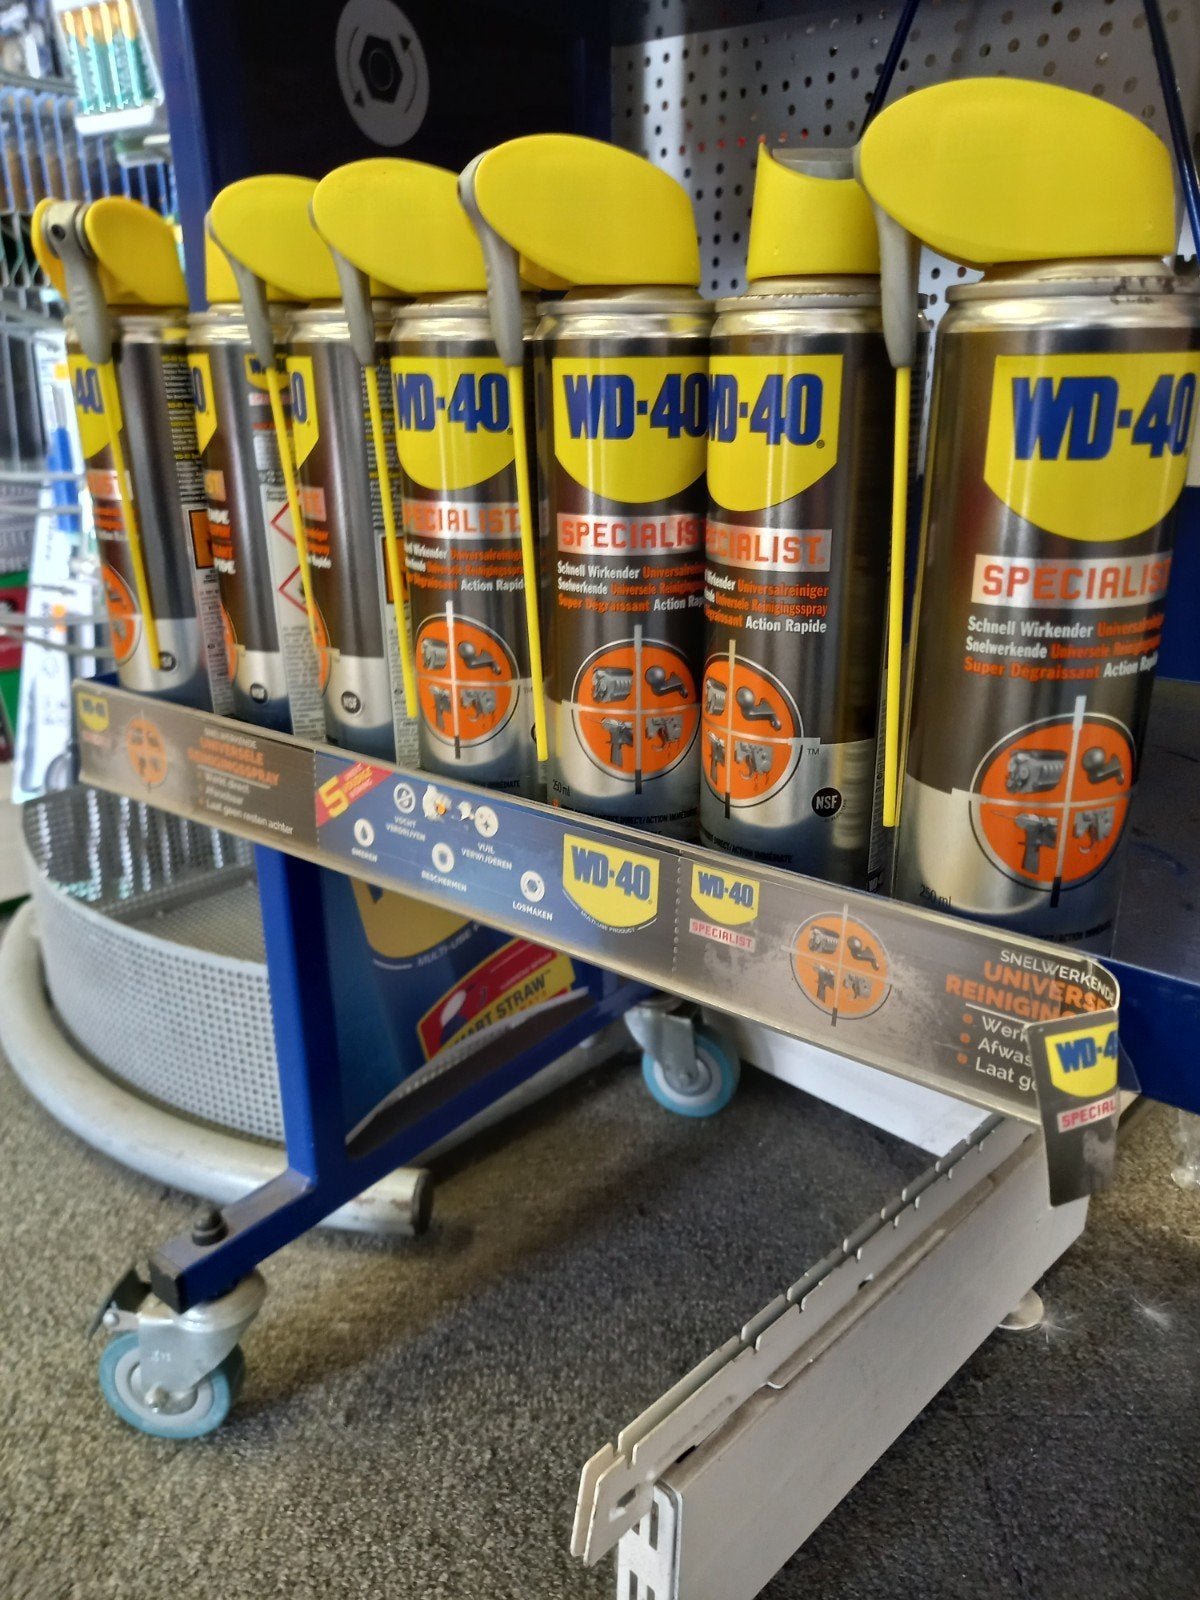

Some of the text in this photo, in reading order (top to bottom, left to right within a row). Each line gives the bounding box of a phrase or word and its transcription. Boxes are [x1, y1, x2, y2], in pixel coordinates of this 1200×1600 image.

[562, 373, 709, 440] WD-40
[1011, 372, 1197, 461] WD-40
[557, 560, 586, 578] Schnell
[588, 563, 640, 579] Wirkender
[460, 578, 493, 592] Action
[496, 577, 525, 592] Rapid
[557, 577, 608, 595] Snelwerkende
[737, 579, 830, 600] Universalreiniger
[653, 597, 686, 612] Action
[688, 595, 705, 608] Rap
[751, 597, 828, 617] Reinigingsspray
[745, 615, 781, 632] Action
[785, 618, 828, 635] Rapide
[967, 615, 1017, 636] Schnell
[1020, 620, 1094, 639] Wirkender
[965, 635, 1048, 659] Snelwerkende
[963, 655, 1006, 677] Super
[1102, 658, 1138, 679] Action
[318, 775, 350, 818] 5
[815, 795, 839, 811] NSF
[461, 848, 513, 871] VERWIJDEREN
[571, 845, 651, 901] WD-40
[697, 871, 754, 909] WD-40
[919, 883, 937, 900] 250
[512, 900, 553, 921] LOSMAKEN
[691, 920, 753, 949] SPECIALIST
[495, 973, 546, 1019] STRAW
[945, 973, 1077, 1022] REINIGIN
[981, 1015, 1029, 1043] Werk
[977, 1036, 1033, 1068] Afwas
[1056, 1030, 1118, 1074] WD-4
[975, 1056, 1015, 1083] Laat
[1061, 1099, 1117, 1128] SPECIAL
